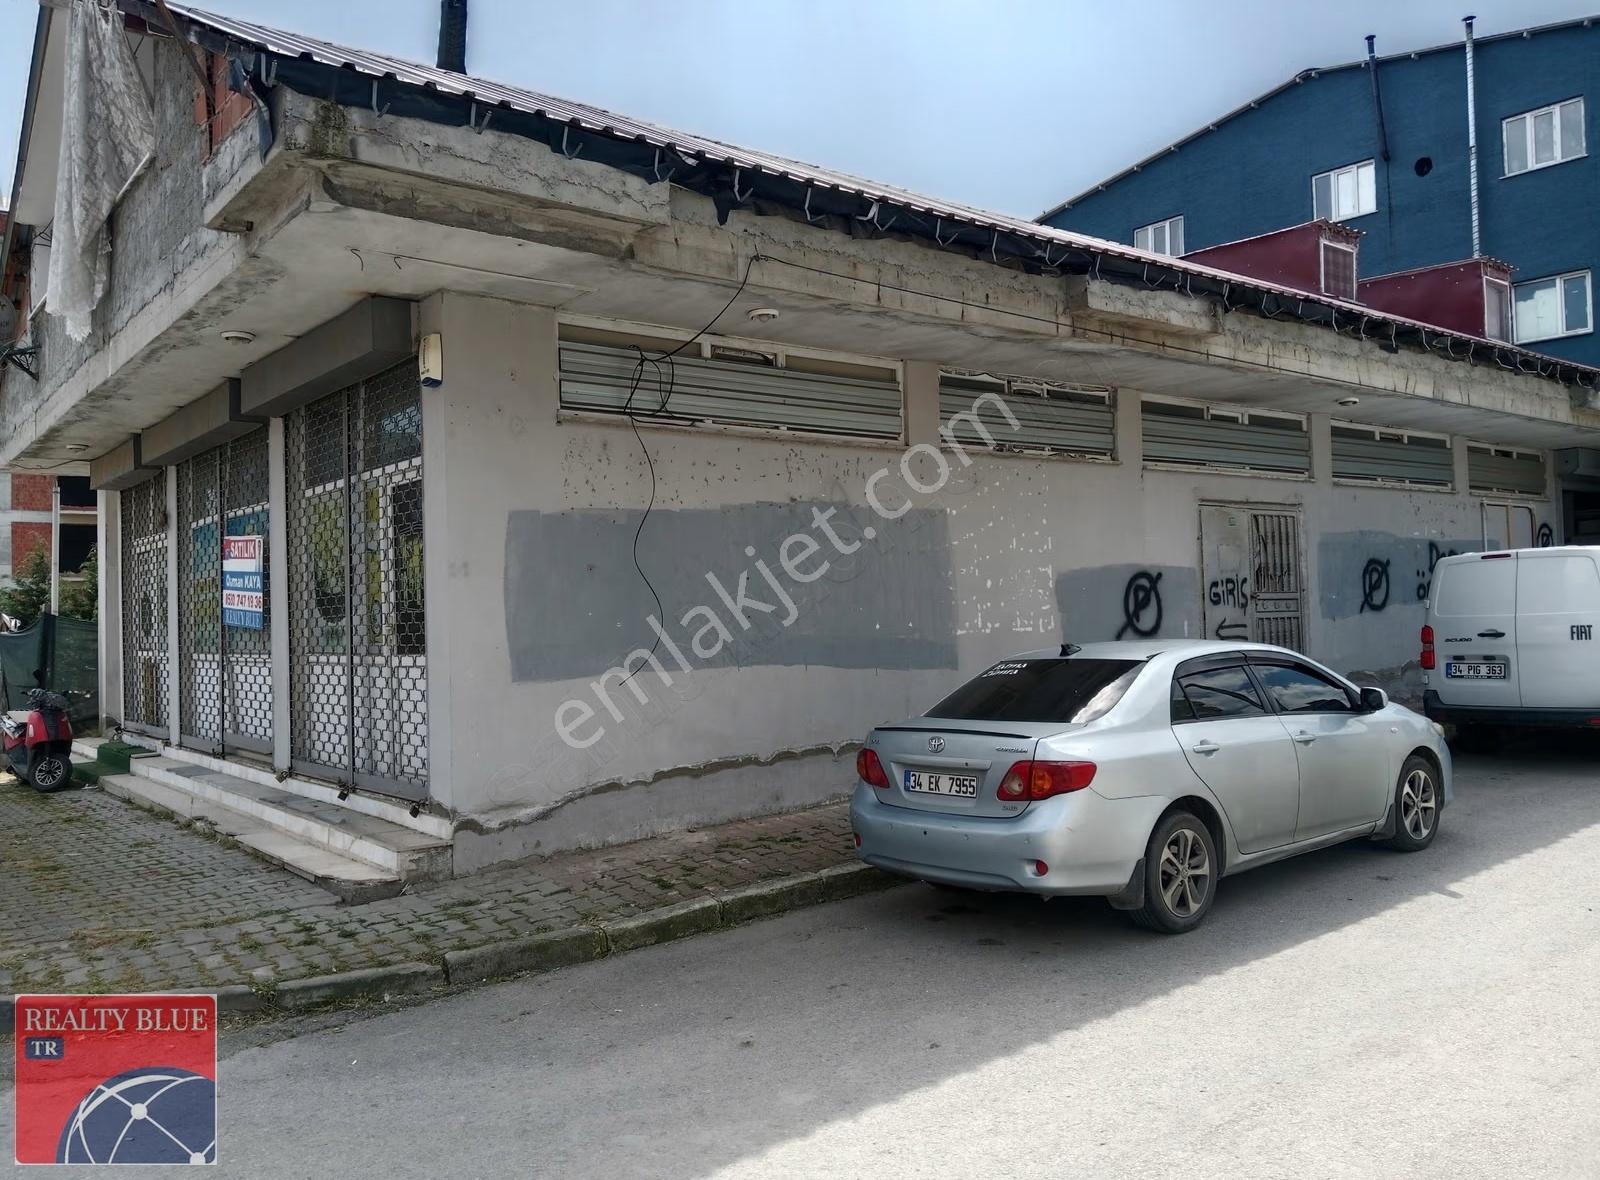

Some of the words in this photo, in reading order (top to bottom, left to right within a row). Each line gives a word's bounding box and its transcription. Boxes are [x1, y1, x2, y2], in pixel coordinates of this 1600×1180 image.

[230, 541, 255, 558] SATILIK
[244, 575, 261, 589] KAYA
[1570, 624, 1592, 641] FIAT
[1452, 665, 1462, 675] 34
[1467, 665, 1481, 675] PIG
[1486, 665, 1503, 675] 363
[910, 773, 922, 790] 34
[928, 775, 941, 792] EK
[948, 776, 976, 796] 7955
